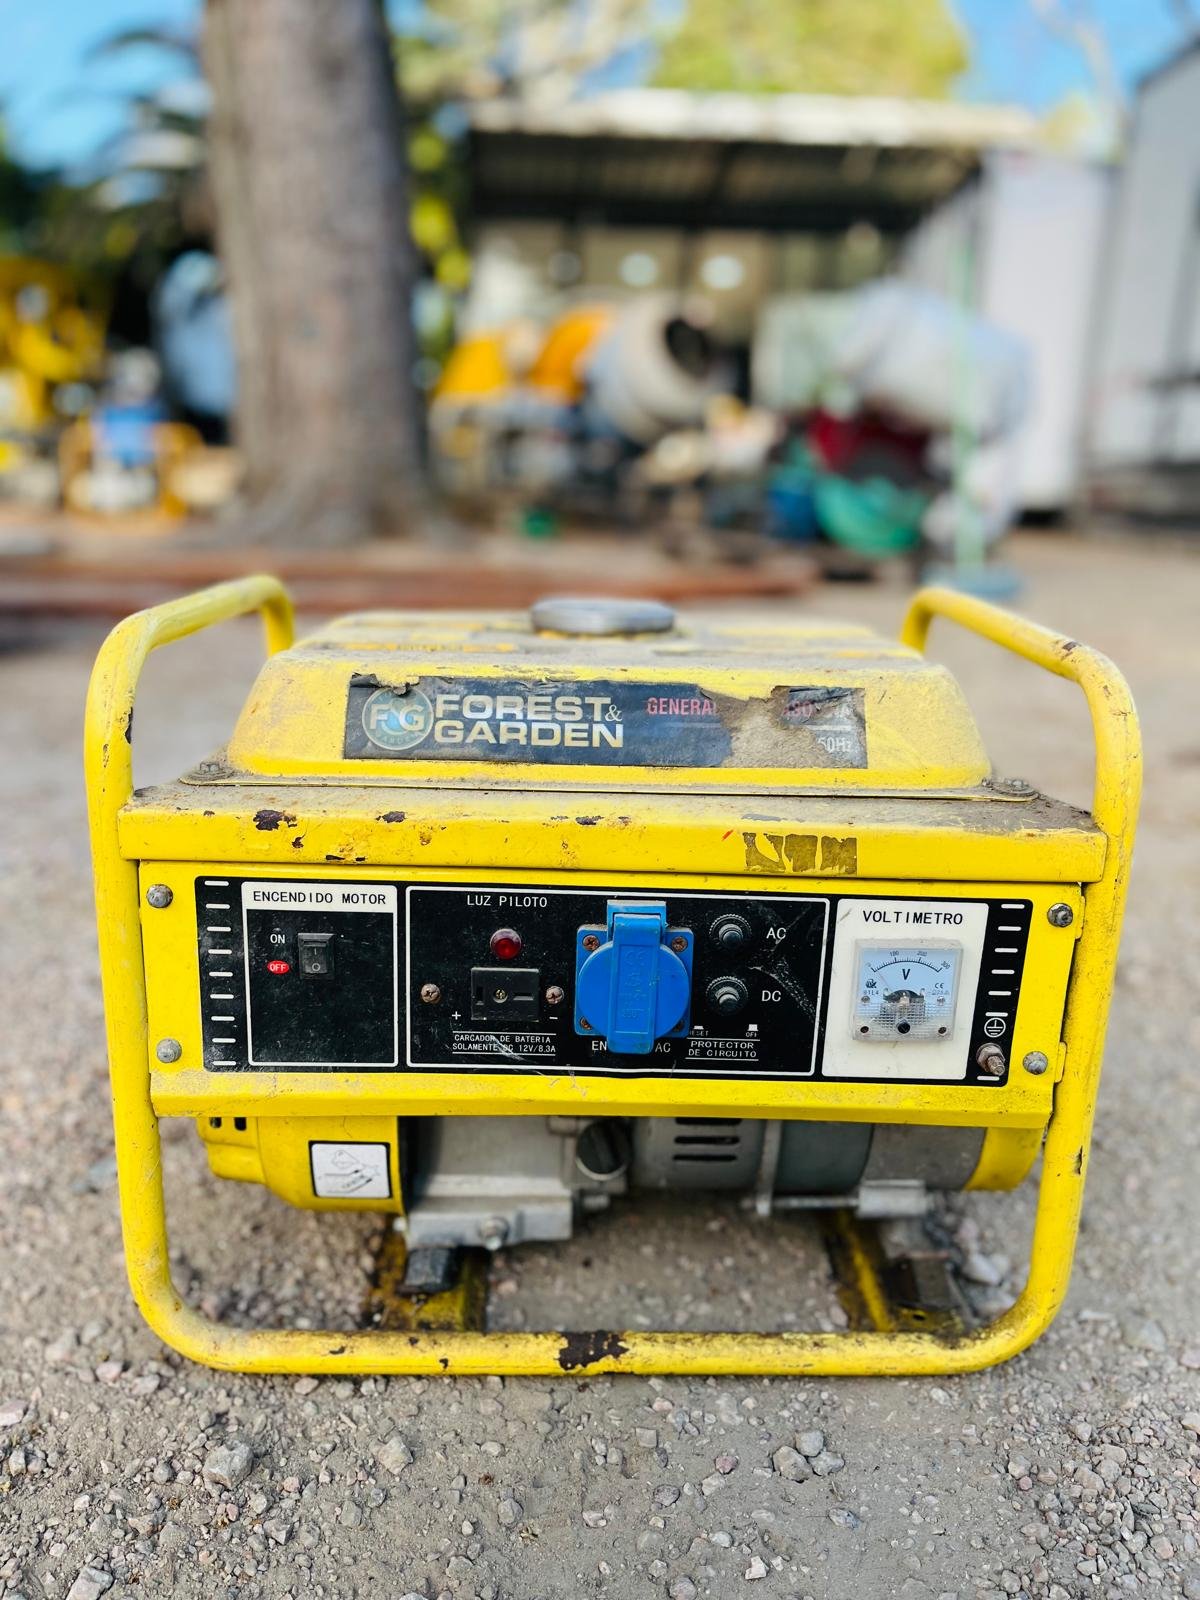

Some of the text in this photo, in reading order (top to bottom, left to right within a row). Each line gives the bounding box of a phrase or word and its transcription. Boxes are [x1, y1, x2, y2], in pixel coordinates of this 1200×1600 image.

[435, 695, 623, 722] FOREST &
[434, 719, 624, 748] GARDEN
[253, 890, 386, 905] ENCENDIDO MOTOR
[467, 894, 548, 908] LUZ PILOTO
[863, 910, 963, 925] VOLTIMETRO
[270, 933, 286, 944] ON
[766, 927, 787, 940] AC
[269, 963, 286, 972] OFF
[902, 968, 911, 981] V
[761, 990, 782, 1002] DC
[500, 1035, 511, 1043] DE
[690, 1040, 754, 1049] PROTECTOR
[452, 1042, 498, 1051] SOLAMENTE
[655, 1042, 671, 1053] AC
[688, 1048, 757, 1058] DE CIRCUITO
